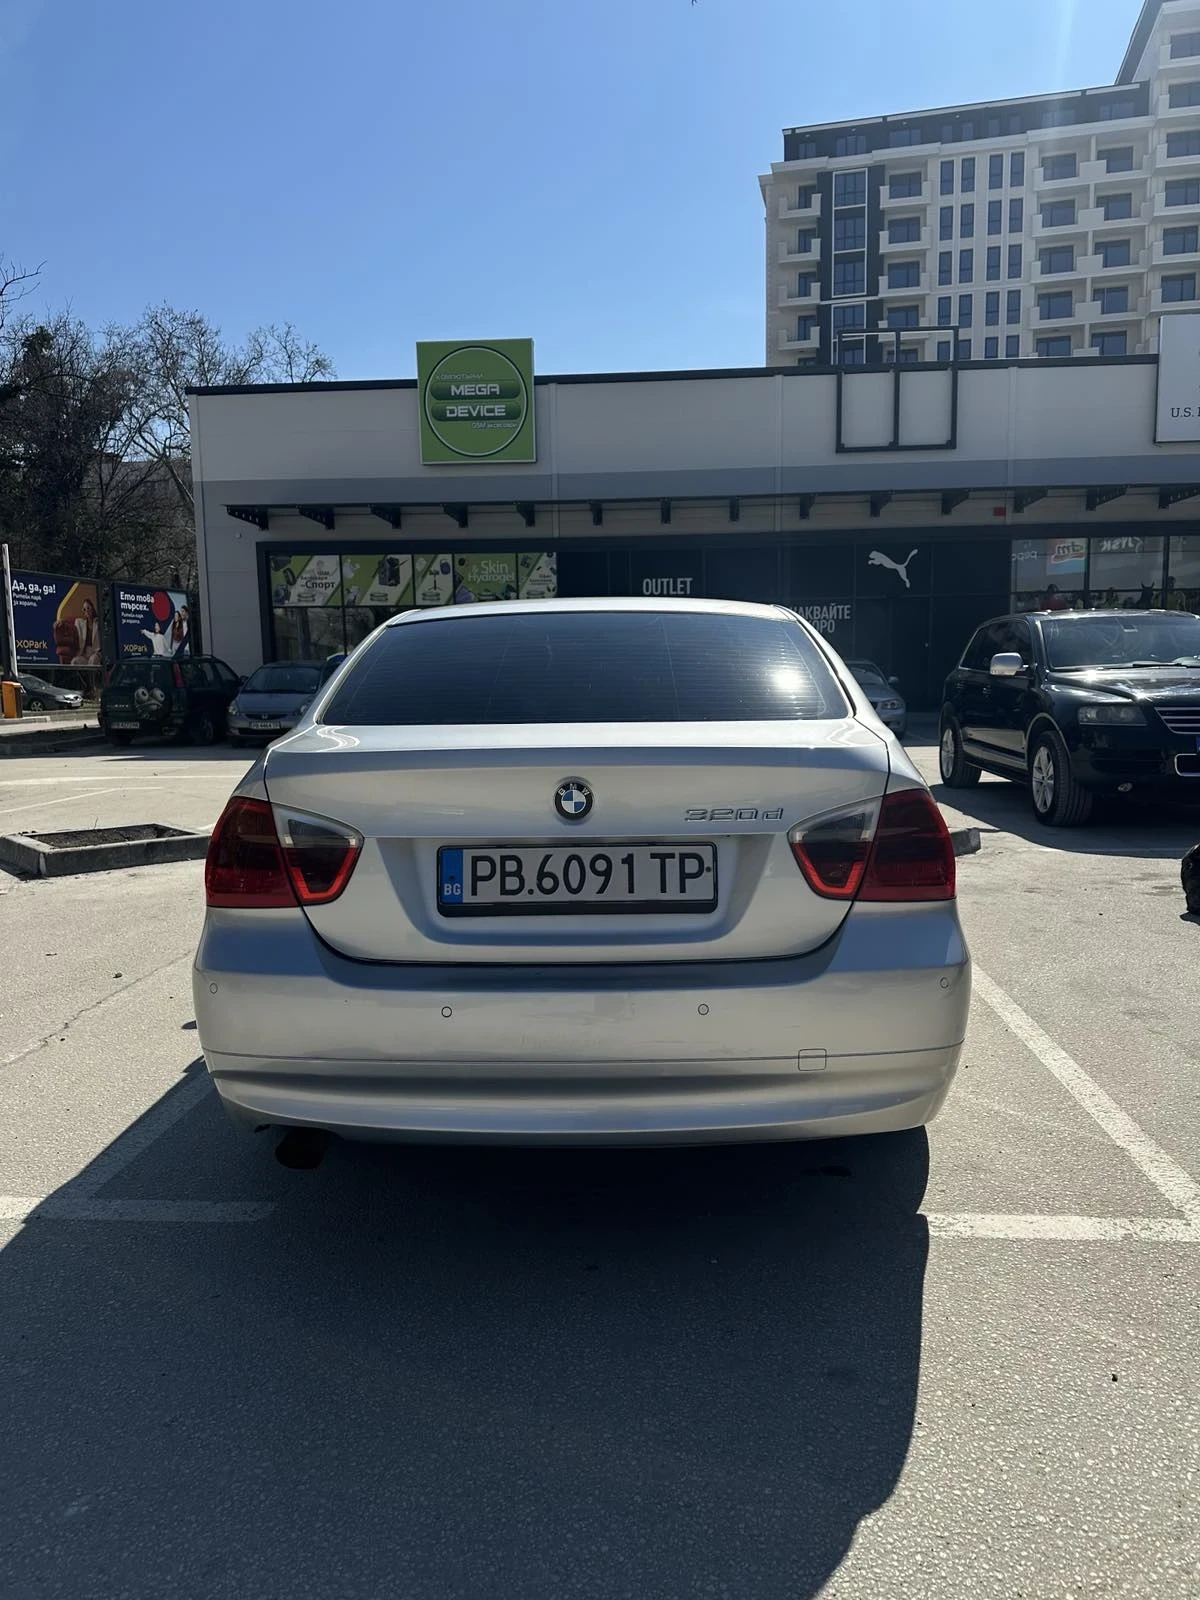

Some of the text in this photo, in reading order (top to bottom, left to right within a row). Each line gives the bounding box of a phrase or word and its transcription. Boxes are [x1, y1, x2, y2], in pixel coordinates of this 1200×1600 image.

[450, 383, 500, 396] MEGA
[445, 404, 506, 418] DEVICE
[481, 560, 508, 574] Skin
[305, 580, 335, 591] Спорт
[468, 572, 515, 585] Hydrogel
[642, 577, 693, 595] OUTLET
[120, 591, 155, 604] Ето това
[808, 619, 836, 633] ОРО
[684, 807, 784, 822] 320d
[649, 852, 706, 895] TP
[444, 883, 461, 896] BG
